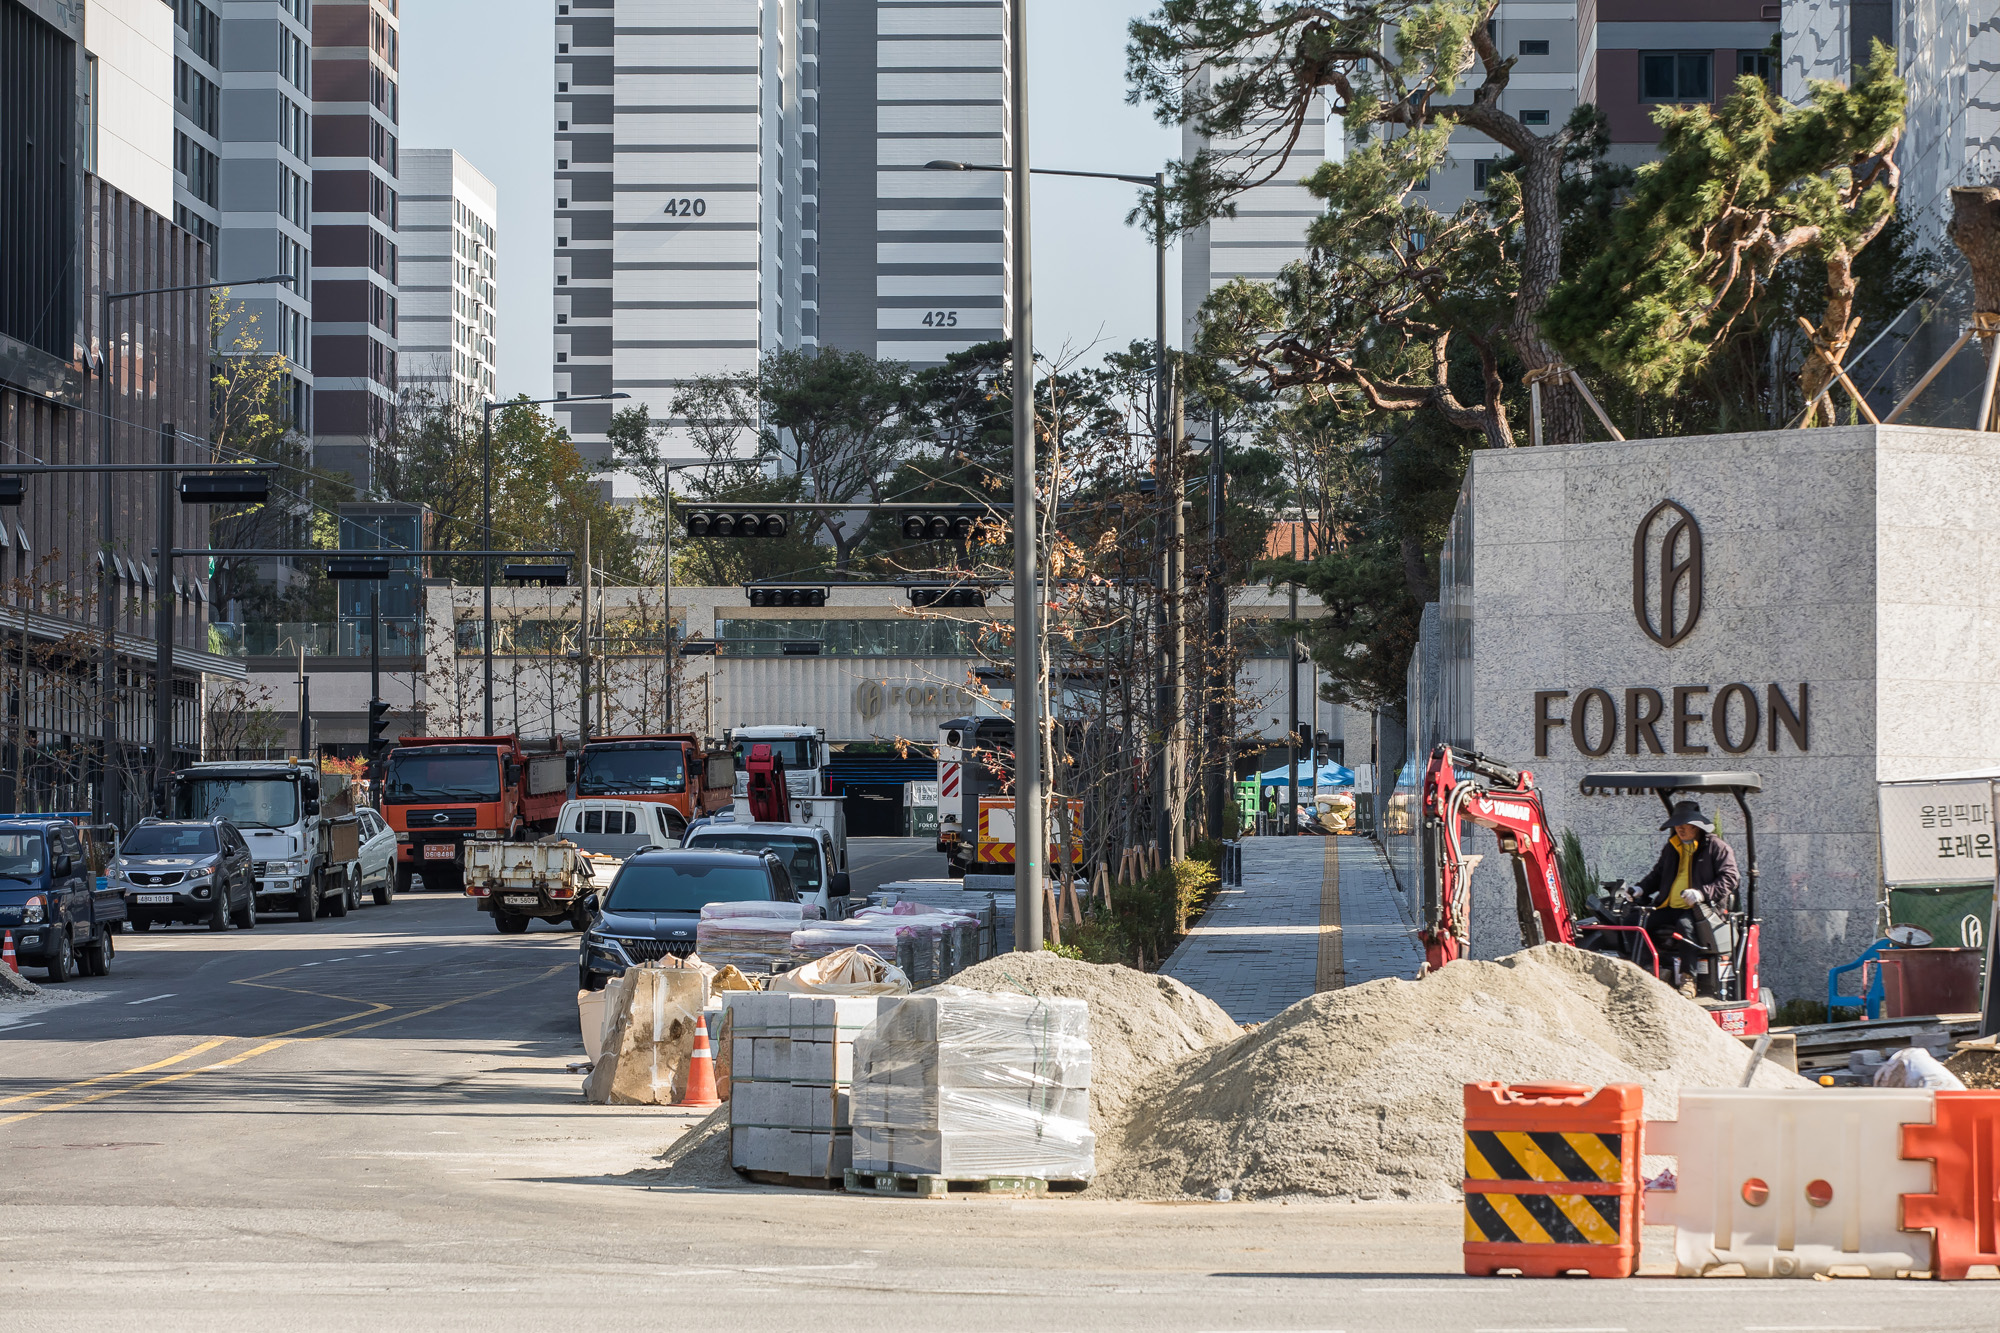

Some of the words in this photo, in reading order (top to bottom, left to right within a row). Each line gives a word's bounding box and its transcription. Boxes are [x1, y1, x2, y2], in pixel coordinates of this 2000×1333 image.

[664, 198, 707, 217] 420
[921, 311, 958, 328] 425
[1534, 682, 1810, 757] FOREON
[1493, 800, 1531, 822] YANMAR
[1919, 803, 1995, 829] 올림픽파
[1937, 833, 1994, 859] 포레온
